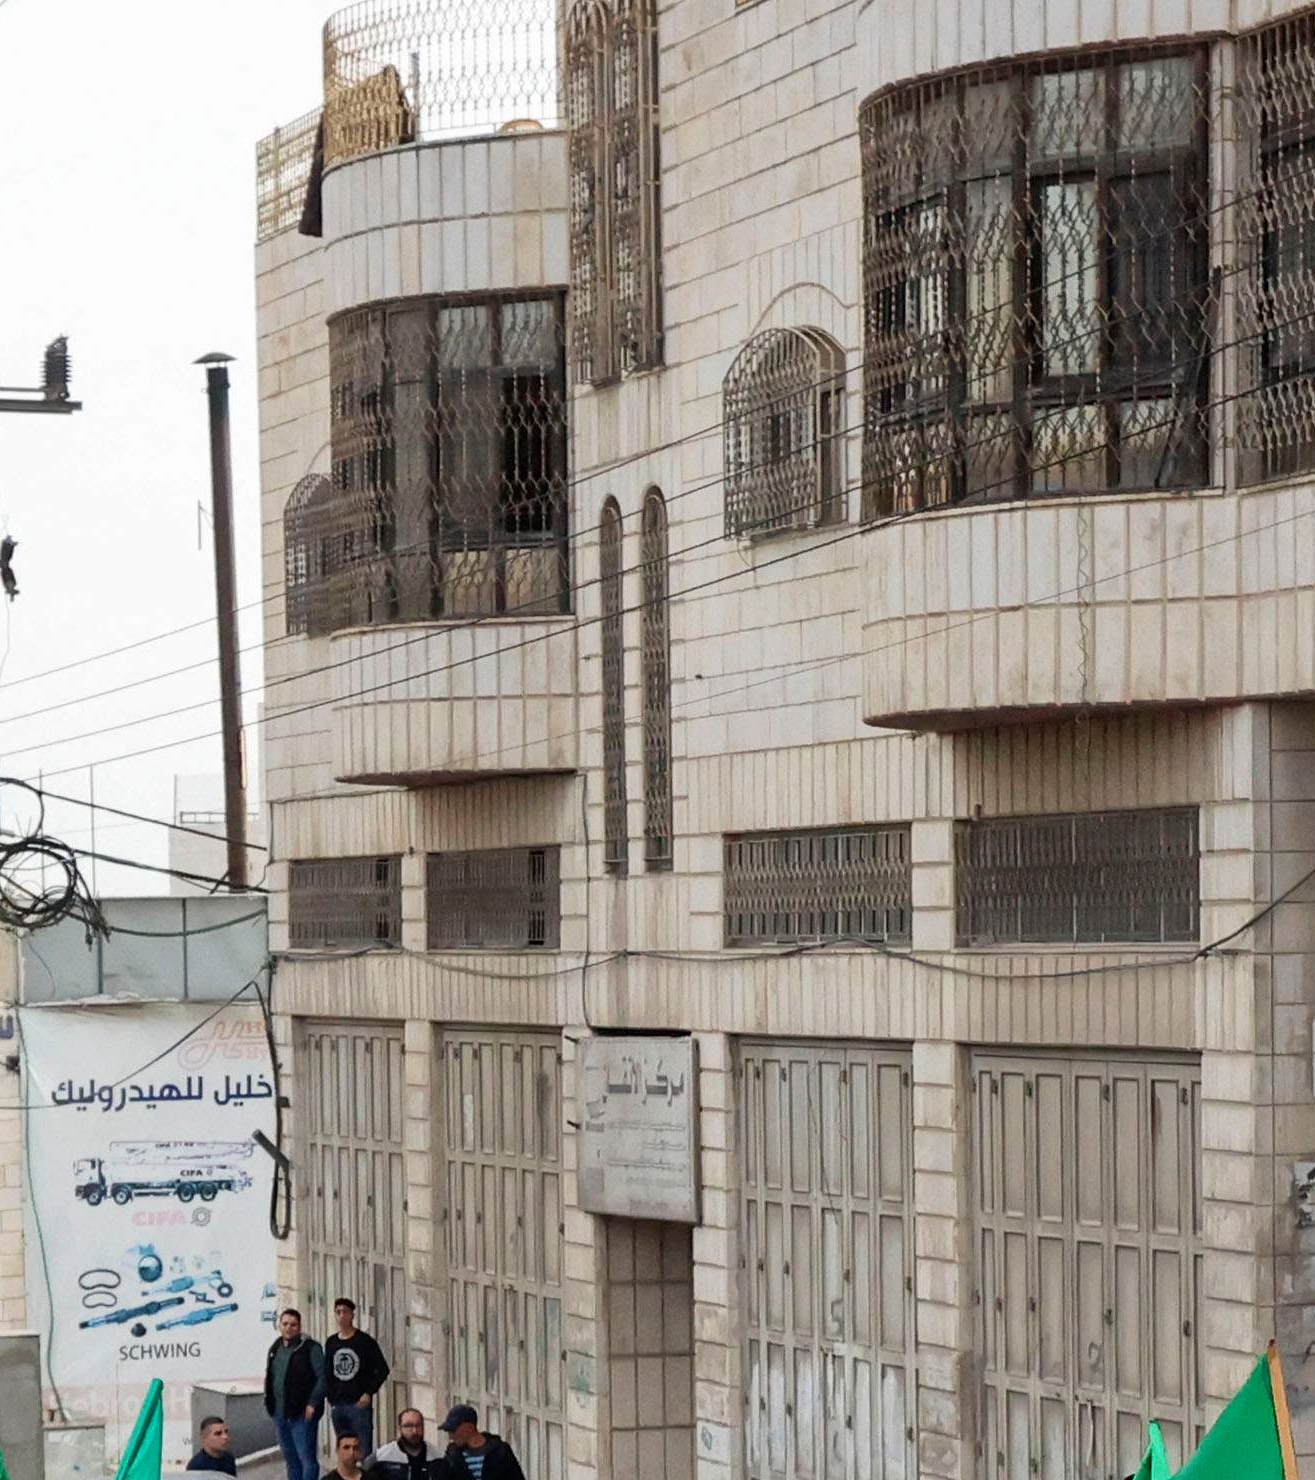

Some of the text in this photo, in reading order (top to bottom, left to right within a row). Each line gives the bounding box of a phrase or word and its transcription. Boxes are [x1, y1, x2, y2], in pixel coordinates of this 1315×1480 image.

[51, 1073, 273, 1112] خليل للهيدروليك
[119, 1342, 201, 1361] SCHWING
